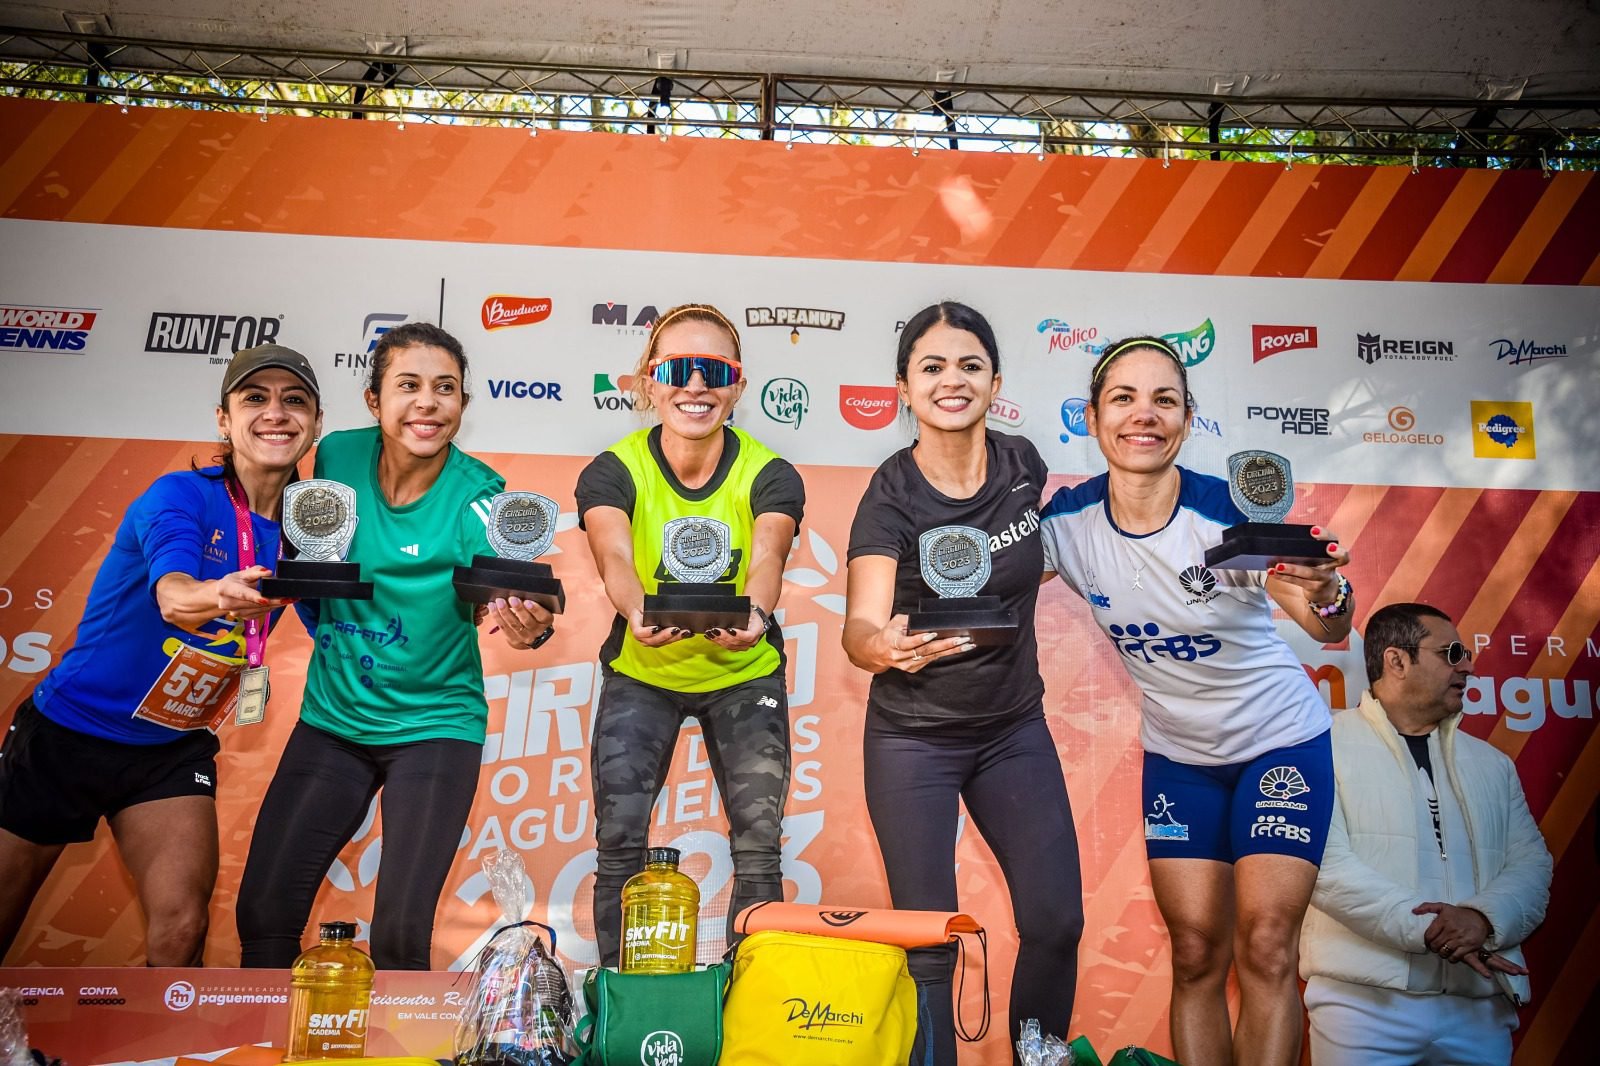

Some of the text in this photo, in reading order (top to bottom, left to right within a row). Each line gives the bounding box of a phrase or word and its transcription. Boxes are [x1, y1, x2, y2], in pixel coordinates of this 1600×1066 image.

[0, 309, 85, 329] WORLD
[486, 299, 548, 325] Bauducco
[747, 308, 844, 330] DR. PEANUT
[0, 328, 88, 350] ENNIS
[150, 314, 281, 355] RUNFOR
[1047, 318, 1098, 354] Molico
[1260, 329, 1310, 351] Royal
[1383, 340, 1454, 355] REIGN
[334, 353, 375, 368] FIN
[488, 380, 563, 401] VIGOR
[769, 383, 802, 403] vida
[594, 396, 637, 410] VON
[845, 397, 892, 408] Colgate
[990, 403, 1020, 420] OLD
[1065, 407, 1087, 428] Yp
[1247, 406, 1330, 421] POWER
[1478, 422, 1526, 434] Pedigree
[1363, 432, 1444, 445] GELO&GELO
[1251, 481, 1278, 495] 2023
[505, 522, 536, 533] 2023
[942, 555, 971, 571] 2023
[163, 663, 231, 705] 551
[1256, 801, 1308, 811] UNICAMP
[626, 921, 690, 941] SKYFIT
[20, 986, 118, 996] GENCIA CONTA
[199, 994, 288, 1005] paguemenos
[782, 998, 863, 1032] DeMarchi
[647, 1035, 677, 1057] vida
